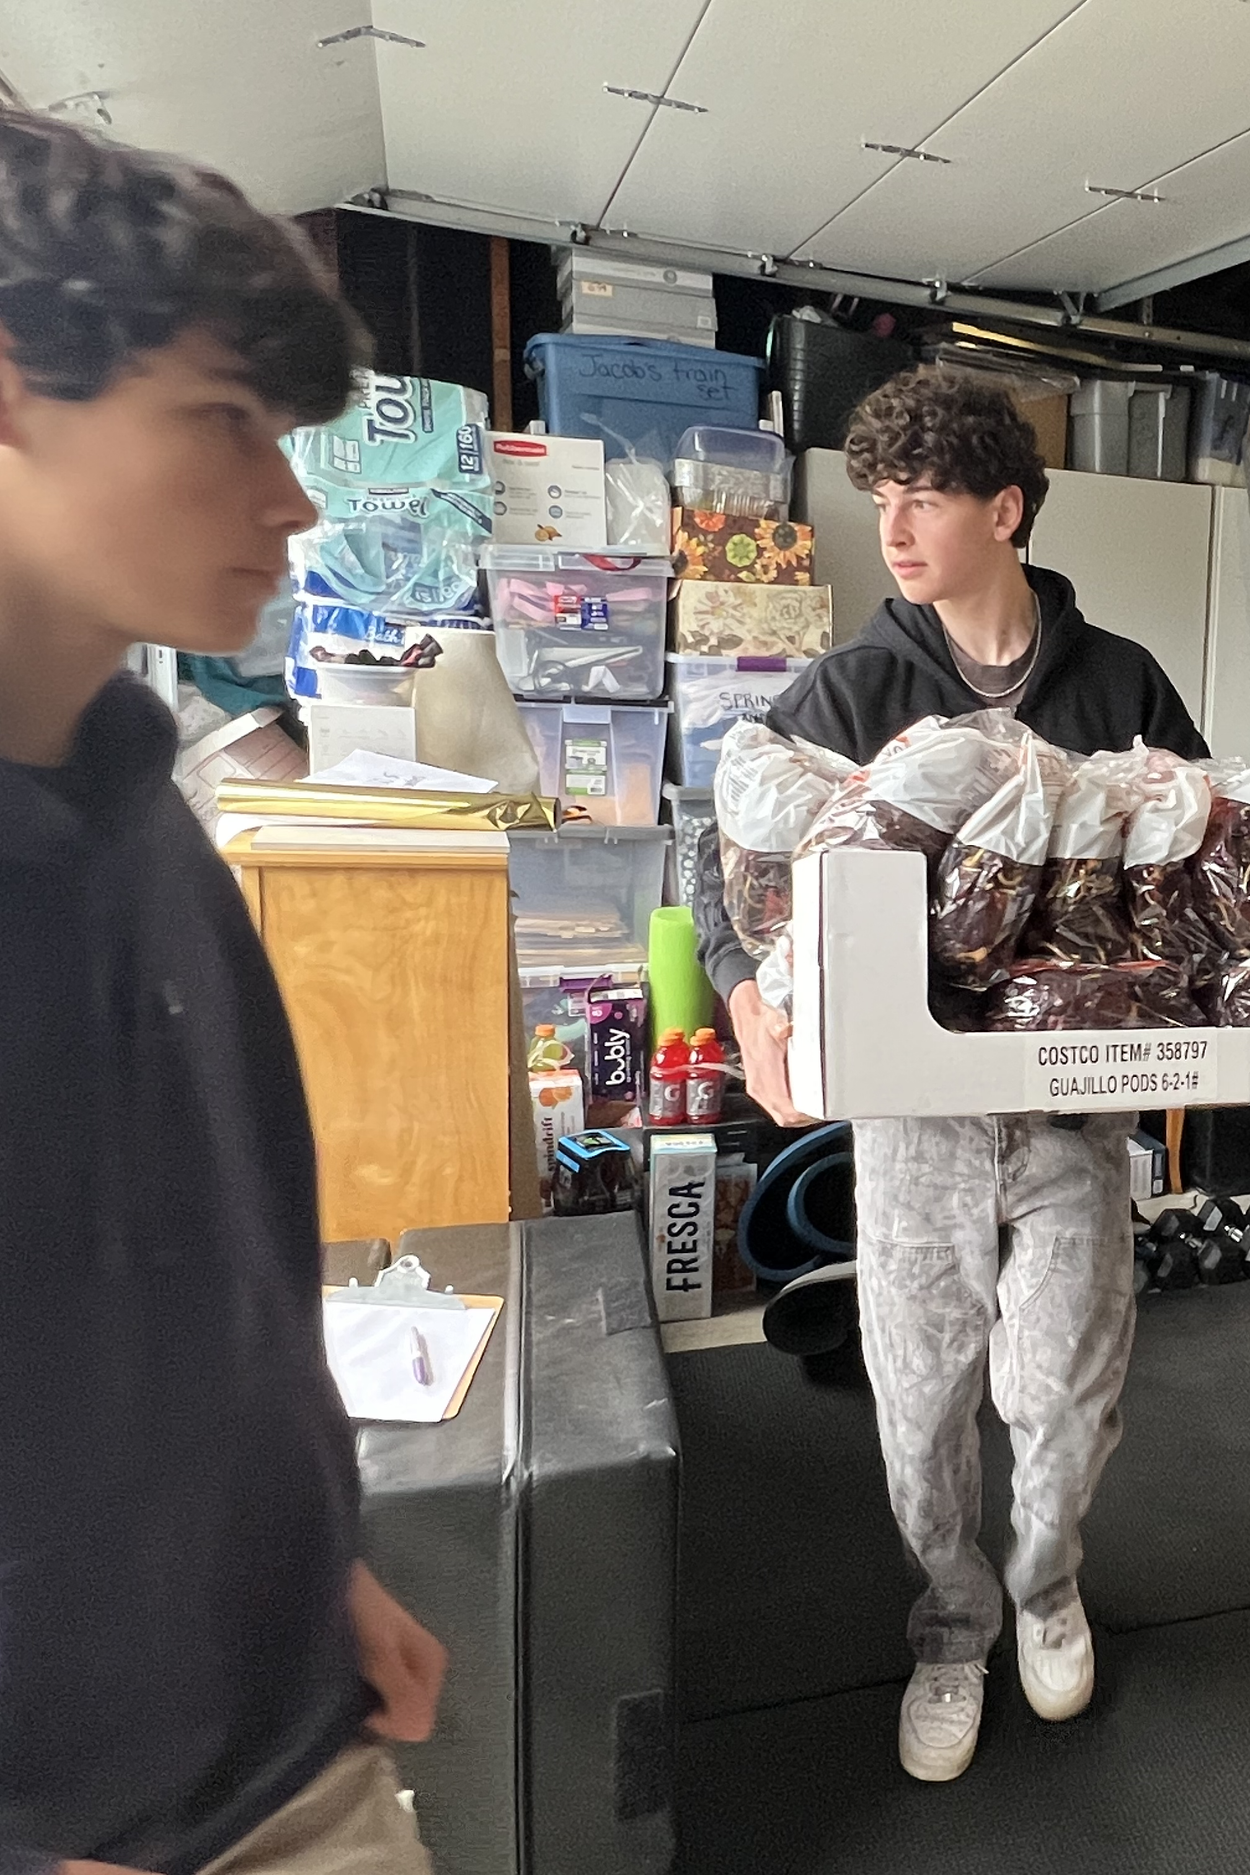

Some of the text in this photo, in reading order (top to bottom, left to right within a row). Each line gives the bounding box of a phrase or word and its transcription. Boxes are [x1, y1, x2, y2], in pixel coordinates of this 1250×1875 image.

[578, 354, 728, 384] Jacob's train
[697, 384, 737, 400] set
[604, 1028, 631, 1086] bubly
[1038, 1041, 1208, 1066] COSTCO ITEM# 358797
[664, 1084, 680, 1101] G
[697, 1081, 714, 1099] G
[1050, 1071, 1199, 1097] GUAJILLO PODS 6-2-1#
[666, 1180, 706, 1293] FRESCA
